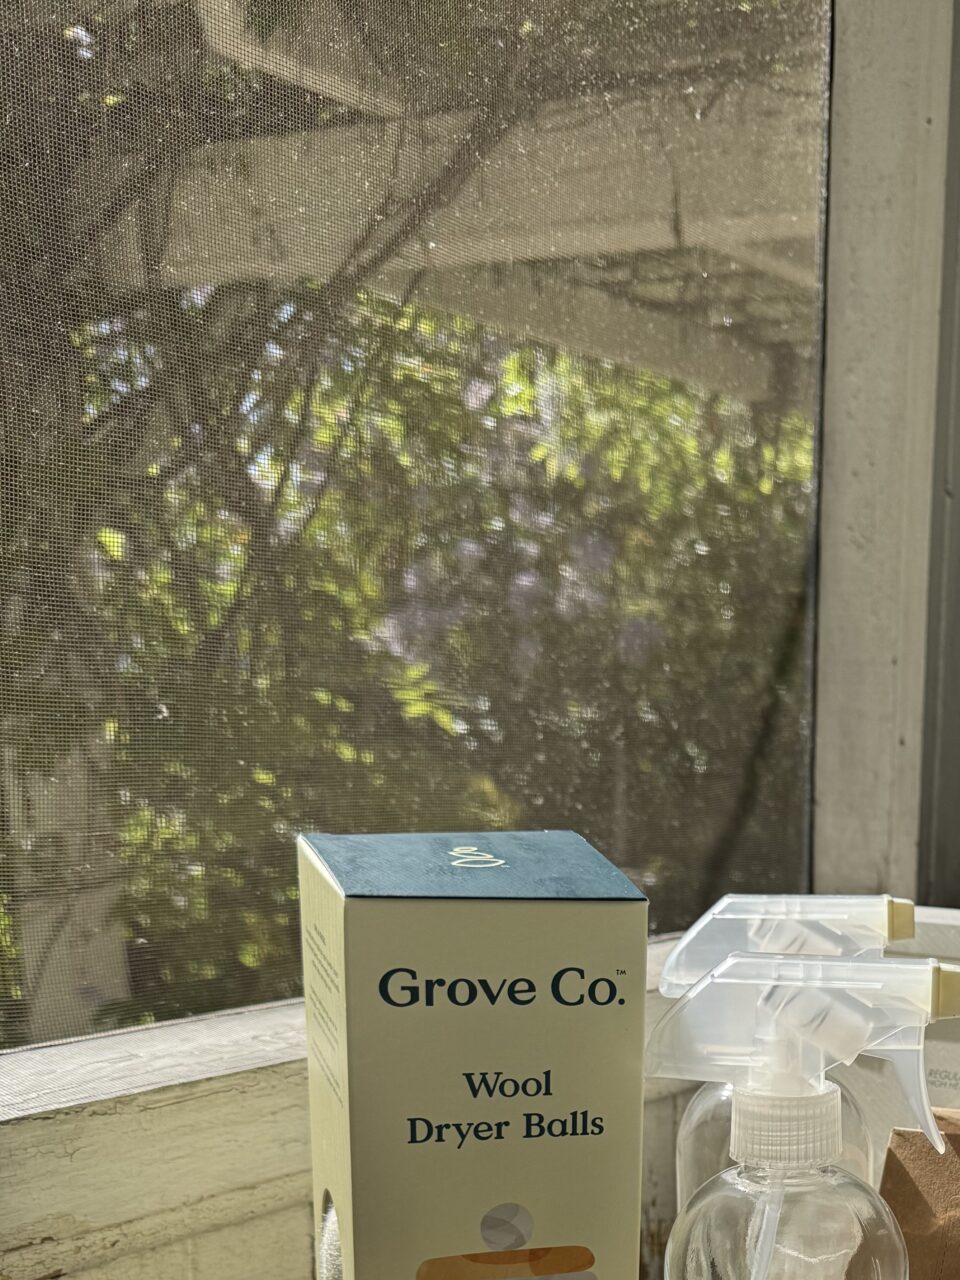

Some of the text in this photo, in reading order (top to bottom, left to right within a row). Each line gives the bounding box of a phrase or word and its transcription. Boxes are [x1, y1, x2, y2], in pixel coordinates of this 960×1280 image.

[378, 967, 537, 1007] Grove
[463, 1070, 552, 1098] Wool
[407, 1110, 605, 1149] Dryer Balls
